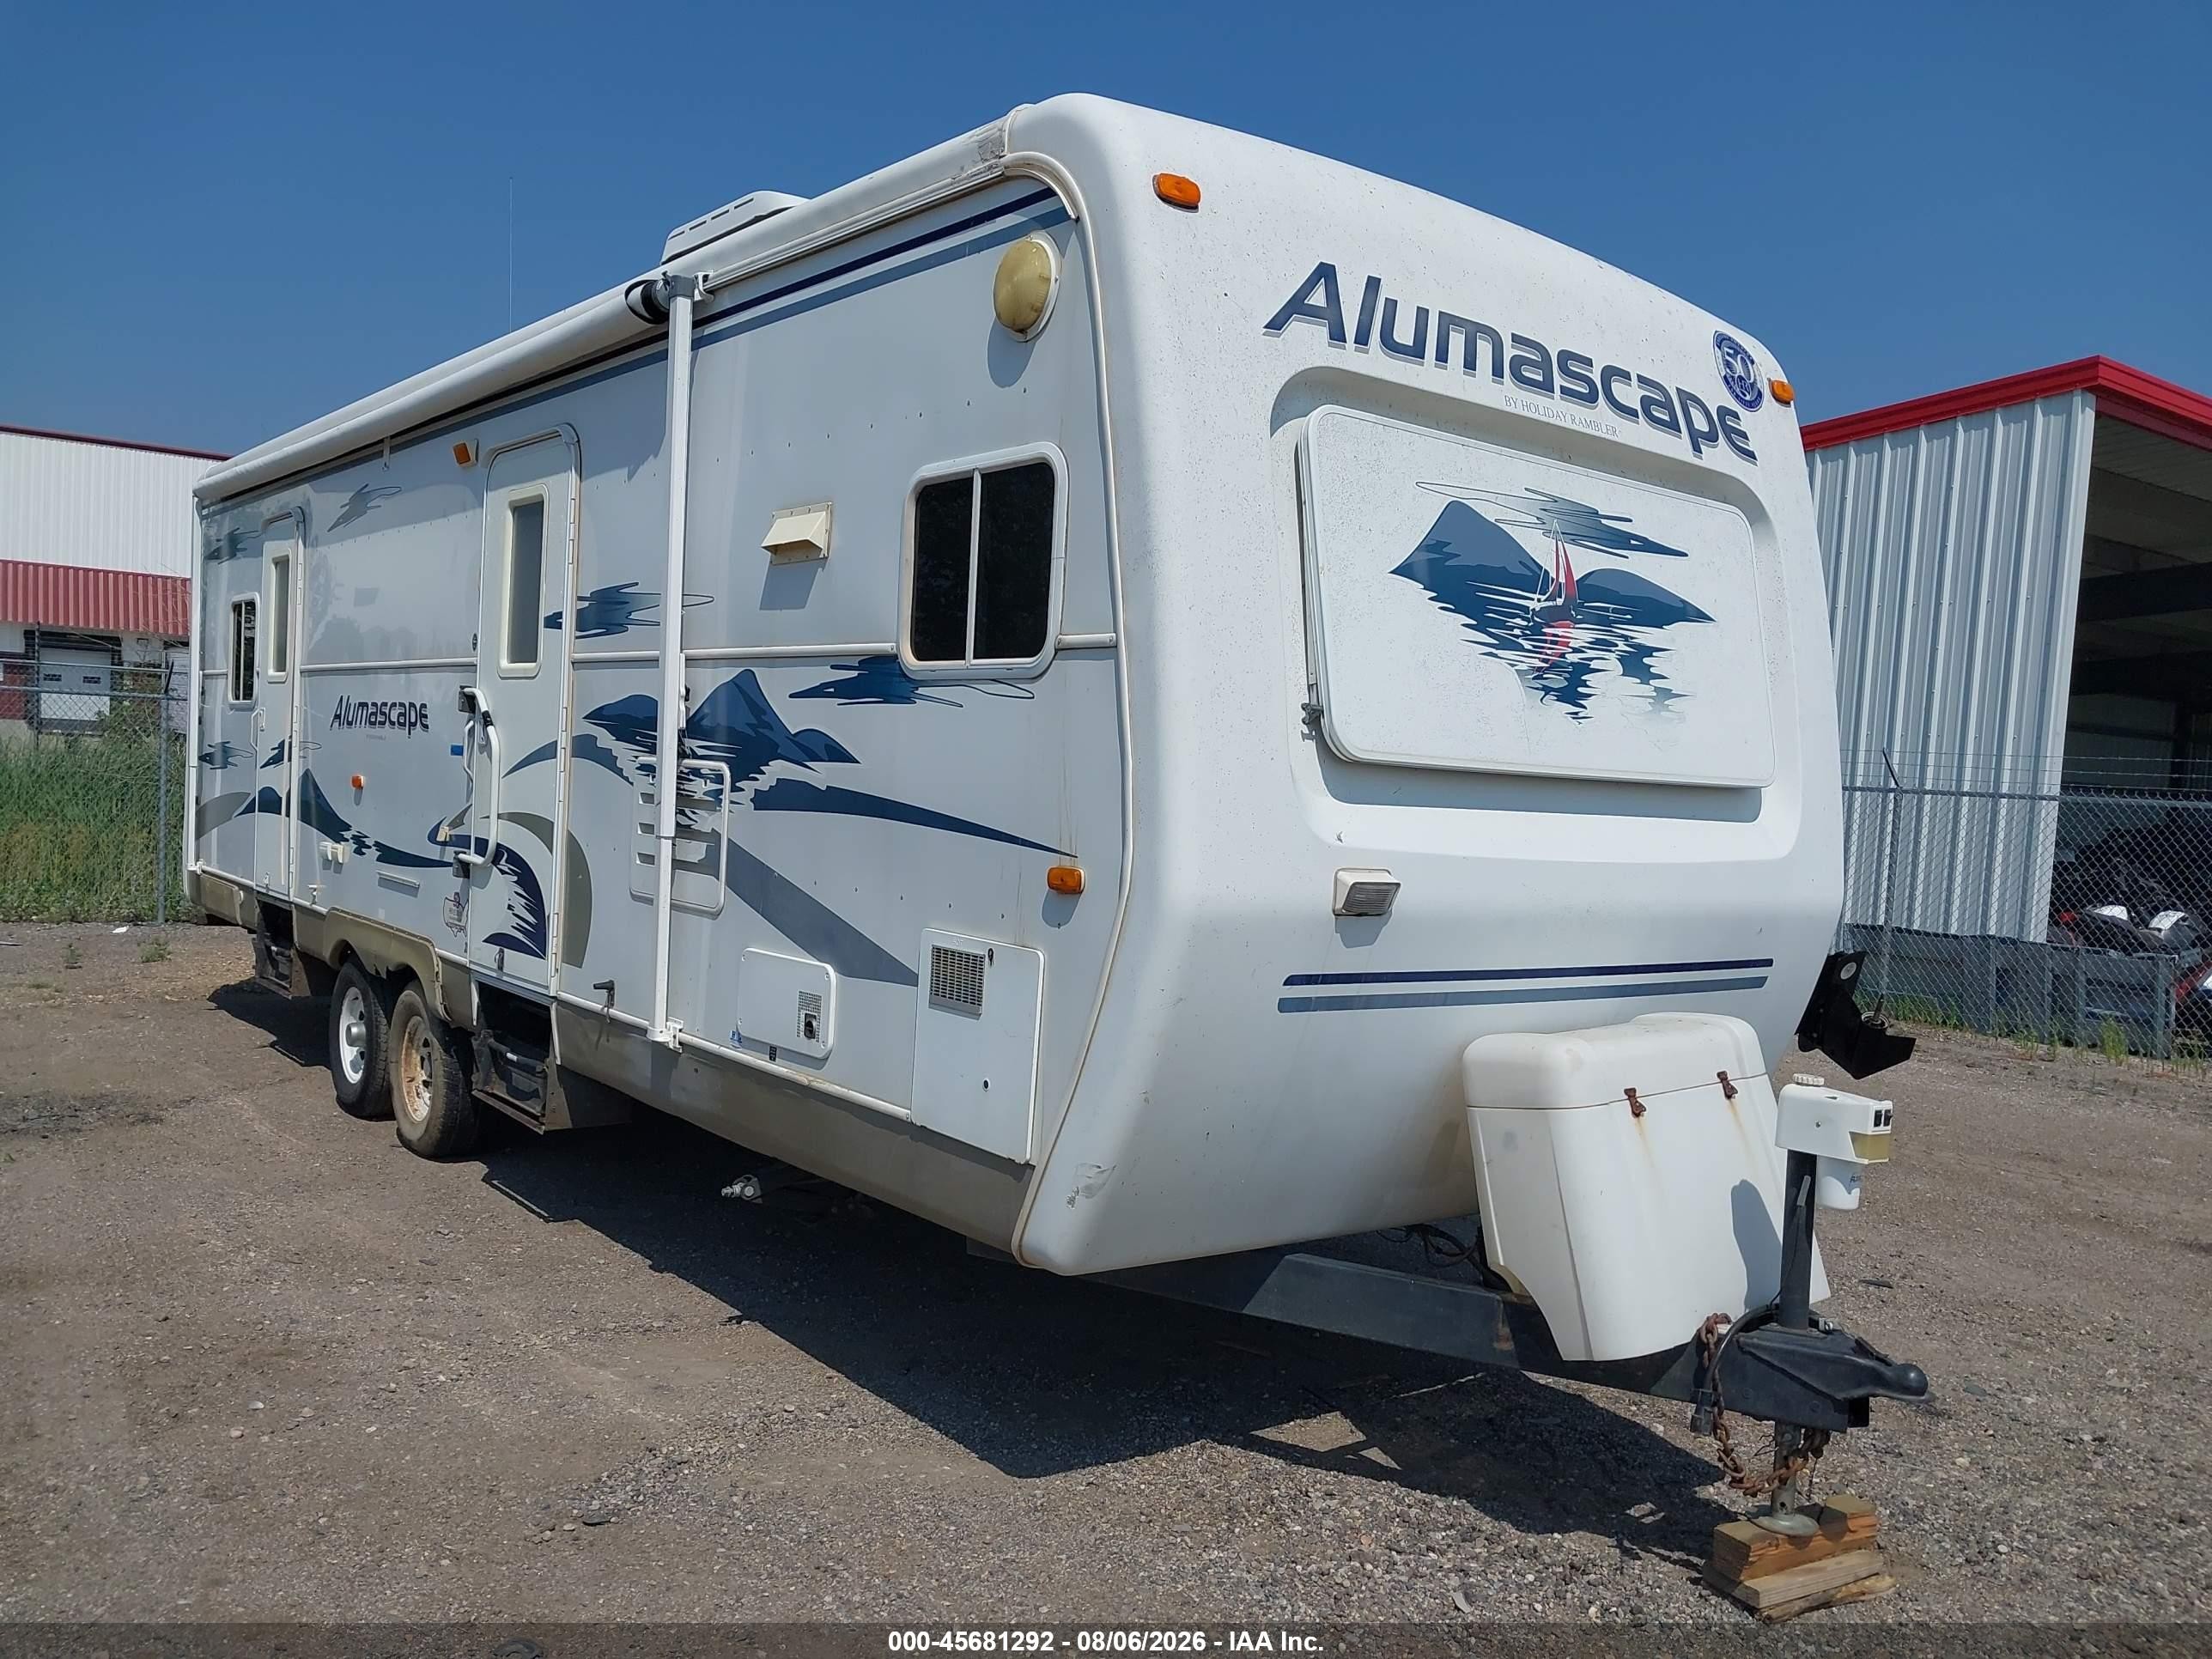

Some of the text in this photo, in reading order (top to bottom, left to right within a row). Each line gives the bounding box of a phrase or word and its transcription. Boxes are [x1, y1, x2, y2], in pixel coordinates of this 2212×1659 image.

[1261, 261, 1759, 466] Alumascape
[1723, 347, 1754, 383] 50
[1504, 395, 1619, 438] BY HOLIDAY RAMBLER
[330, 695, 429, 738] Alumascape
